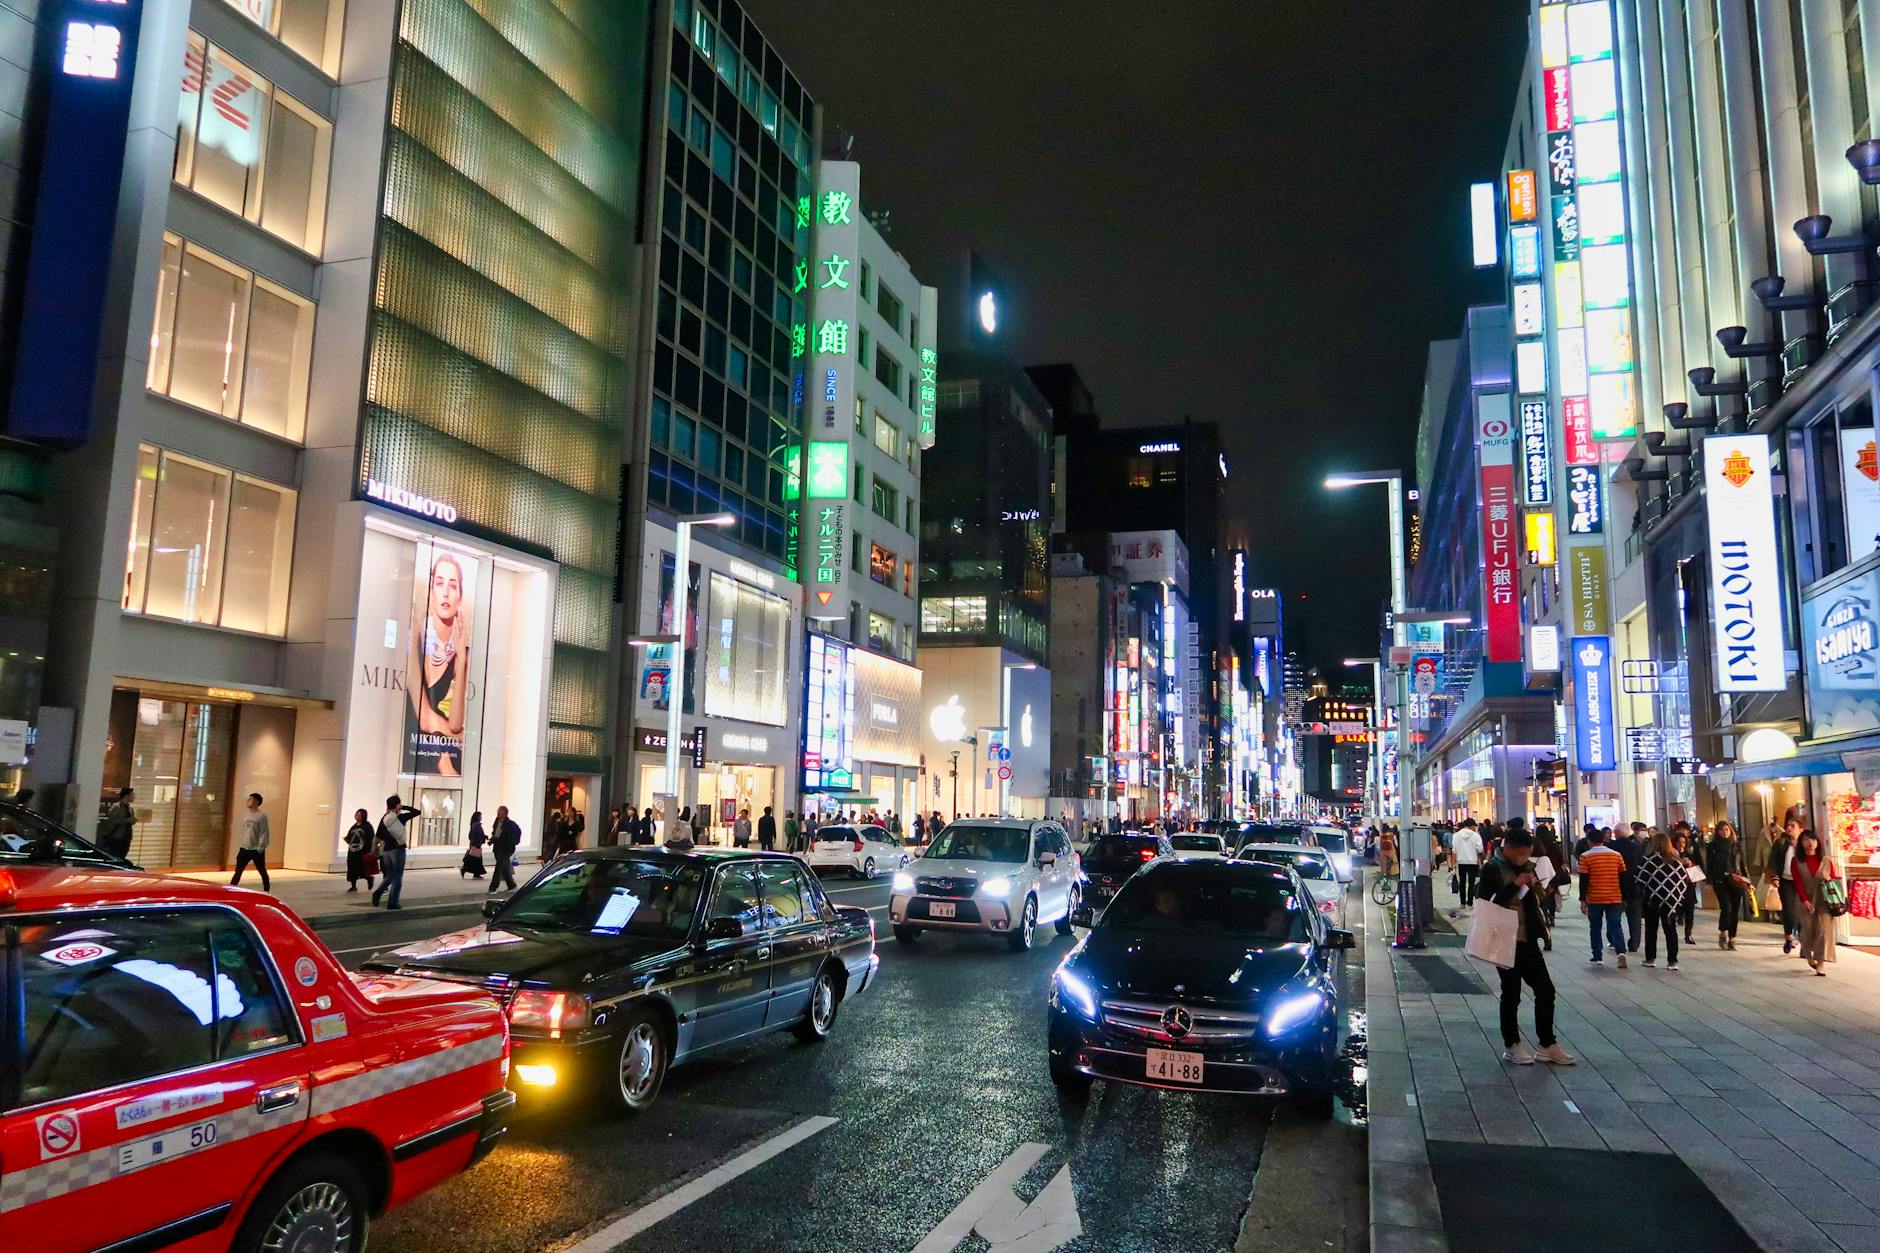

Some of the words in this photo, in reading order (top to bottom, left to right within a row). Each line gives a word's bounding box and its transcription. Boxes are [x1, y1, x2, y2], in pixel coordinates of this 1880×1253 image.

[819, 191, 852, 355] 教文館
[826, 368, 837, 401] SINCE
[920, 348, 937, 434] 教文館ビル
[1140, 443, 1180, 453] CHANEL
[1483, 438, 1509, 447] MUFG
[814, 452, 844, 490] 本
[367, 479, 457, 523] MIKIMOTO
[817, 507, 836, 583] ナルニア国
[1489, 486, 1513, 604] 三菱UFJ銀行
[1580, 557, 1593, 600] BIRTH
[1593, 574, 1601, 599] GINZA
[1583, 605, 1594, 618] SA
[1586, 670, 1601, 724] ASSCHER
[410, 733, 459, 748] MIKIMOTO
[1590, 726, 1602, 765] ROYAL
[1159, 1062, 1200, 1080] 41-88
[191, 1123, 217, 1147] 50
